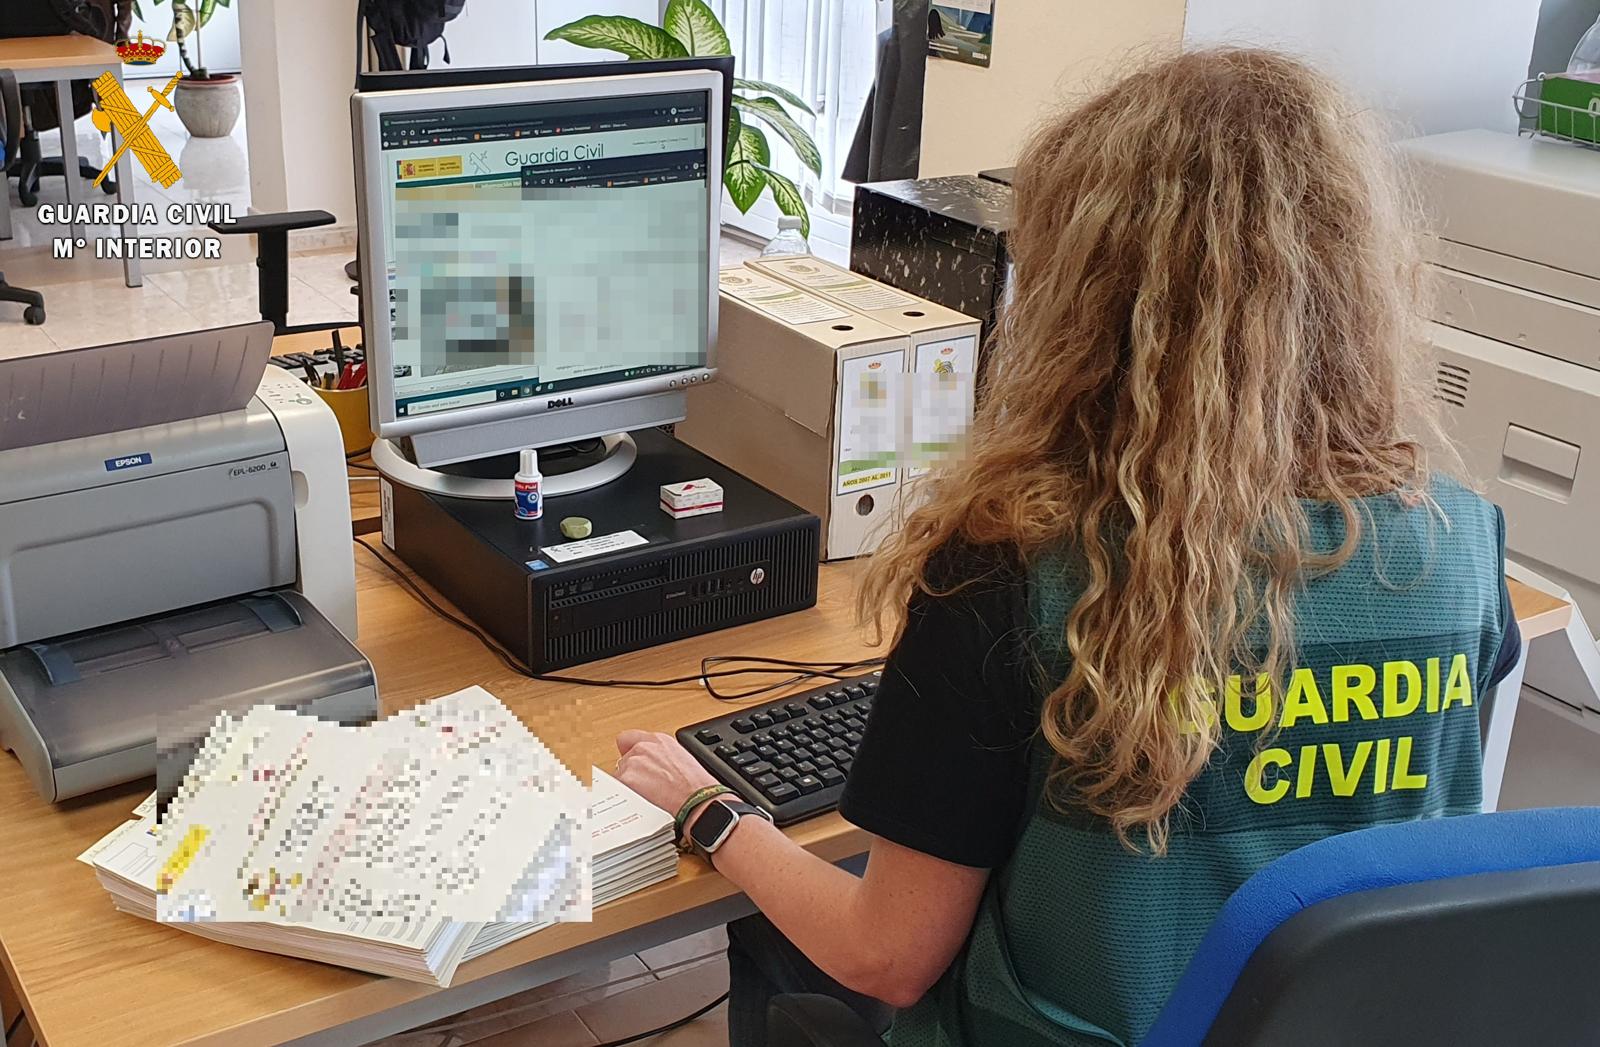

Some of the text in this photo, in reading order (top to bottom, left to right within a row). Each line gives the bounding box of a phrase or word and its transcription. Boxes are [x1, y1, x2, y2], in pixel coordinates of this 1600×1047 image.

[505, 143, 604, 166] Guardia Civil
[547, 397, 574, 409] DELL
[115, 456, 142, 467] EPSON
[233, 463, 266, 476] EPL-6200
[750, 568, 765, 585] hp
[1243, 736, 1428, 804] CIVIL
